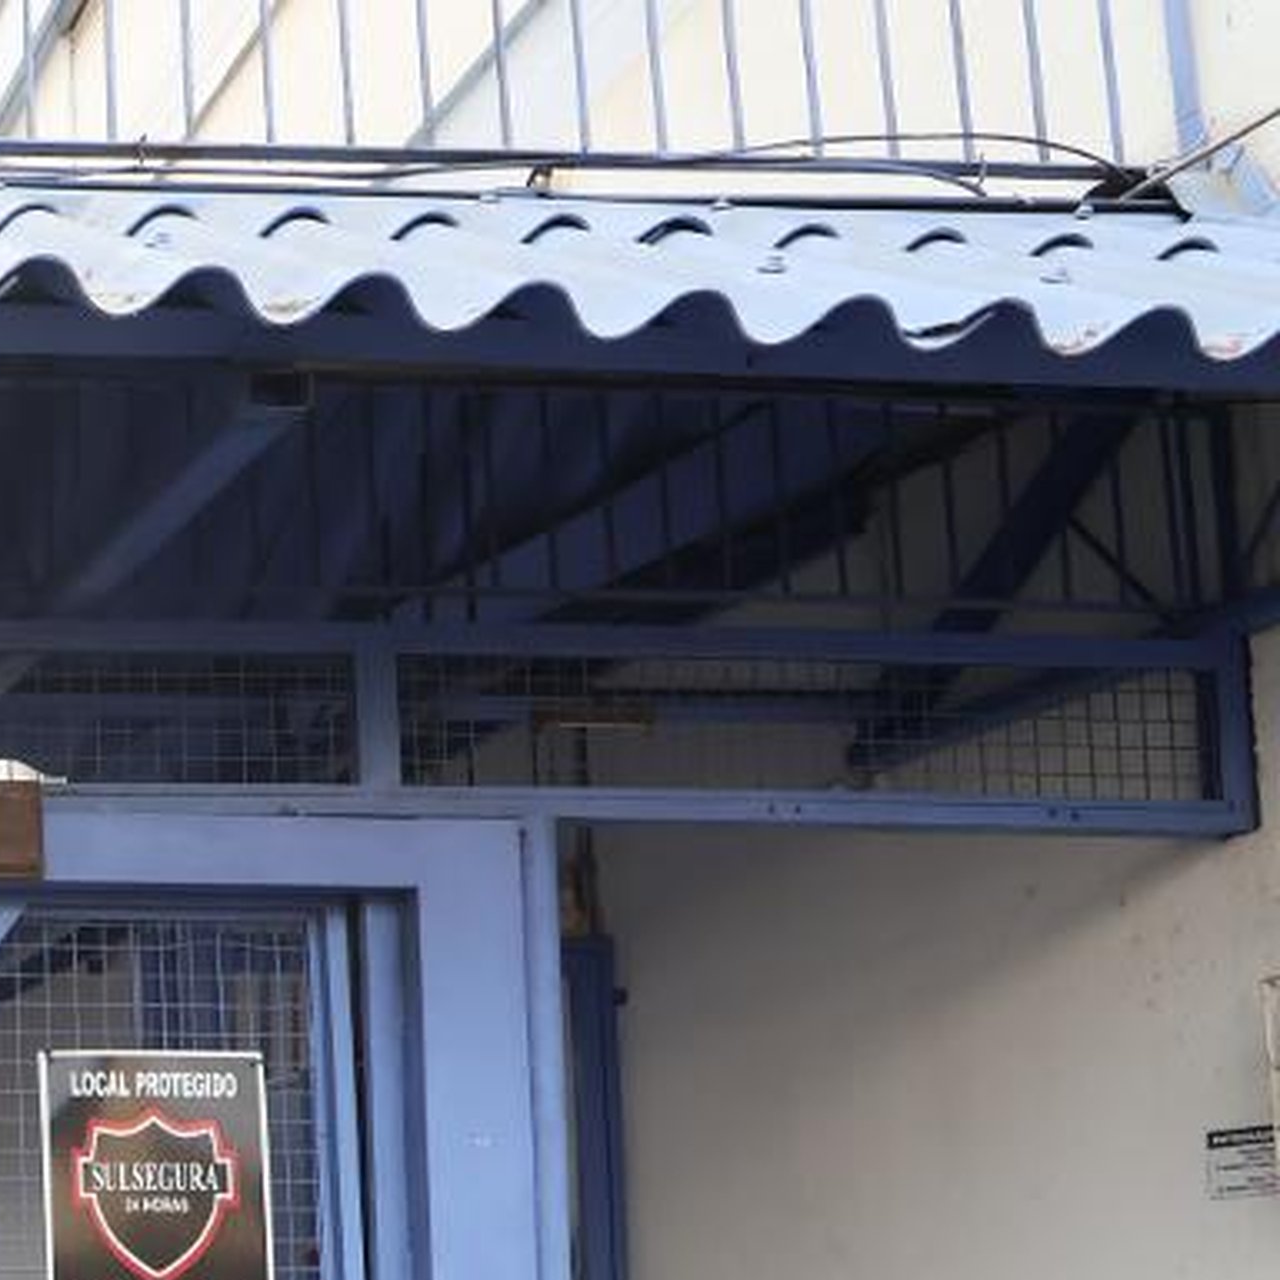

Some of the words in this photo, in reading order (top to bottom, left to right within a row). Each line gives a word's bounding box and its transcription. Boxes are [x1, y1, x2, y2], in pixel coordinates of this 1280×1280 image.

[69, 1071, 130, 1097] LOCAL
[135, 1072, 238, 1099] PROTEGIDO
[91, 1161, 219, 1192] SULSEGURA
